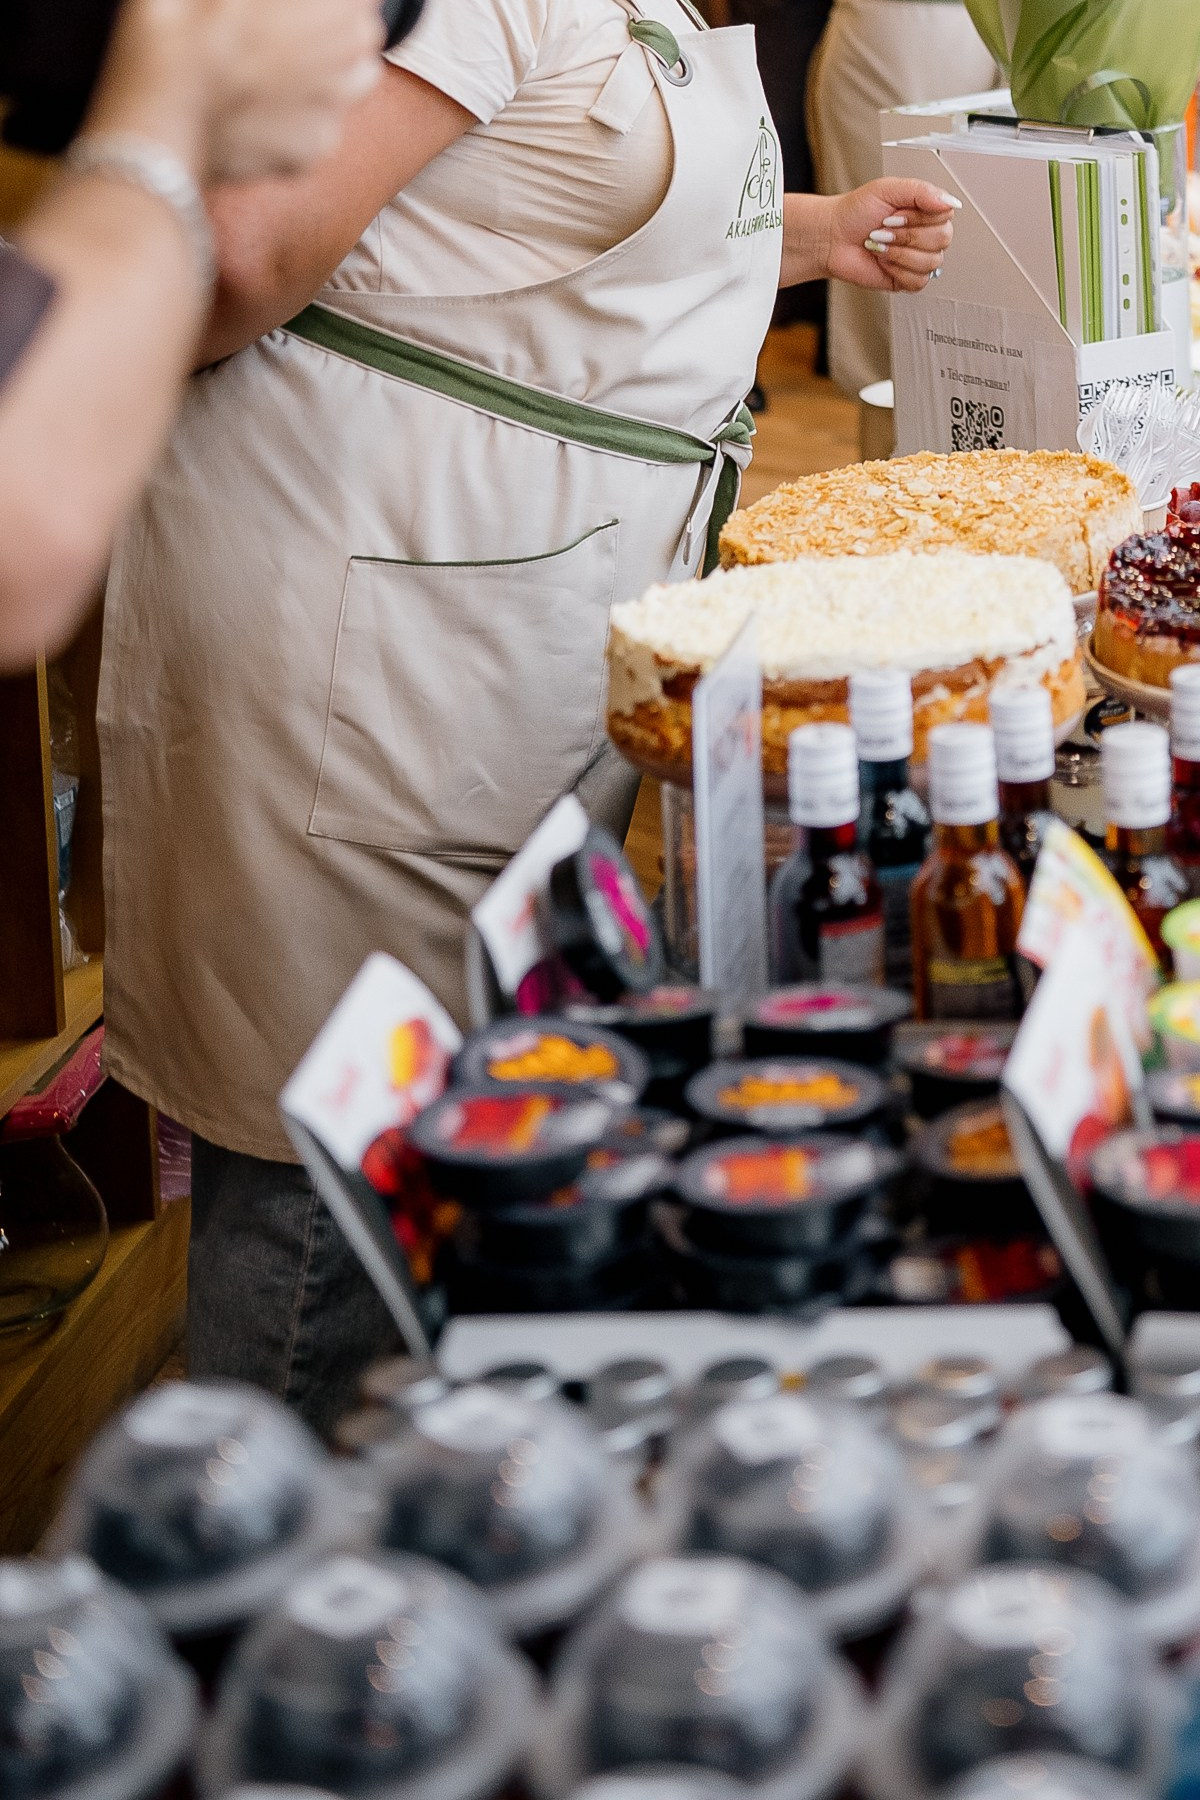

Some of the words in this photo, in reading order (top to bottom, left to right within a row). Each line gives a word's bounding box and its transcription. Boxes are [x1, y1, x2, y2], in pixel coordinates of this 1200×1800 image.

[725, 214, 764, 239] АКАДЕ
[926, 329, 998, 354] Присоединяйтесь
[1000, 346, 1006, 355] к
[1006, 348, 1023, 358] нам
[940, 369, 945, 378] в
[946, 368, 1010, 392] Telegram-канал!
